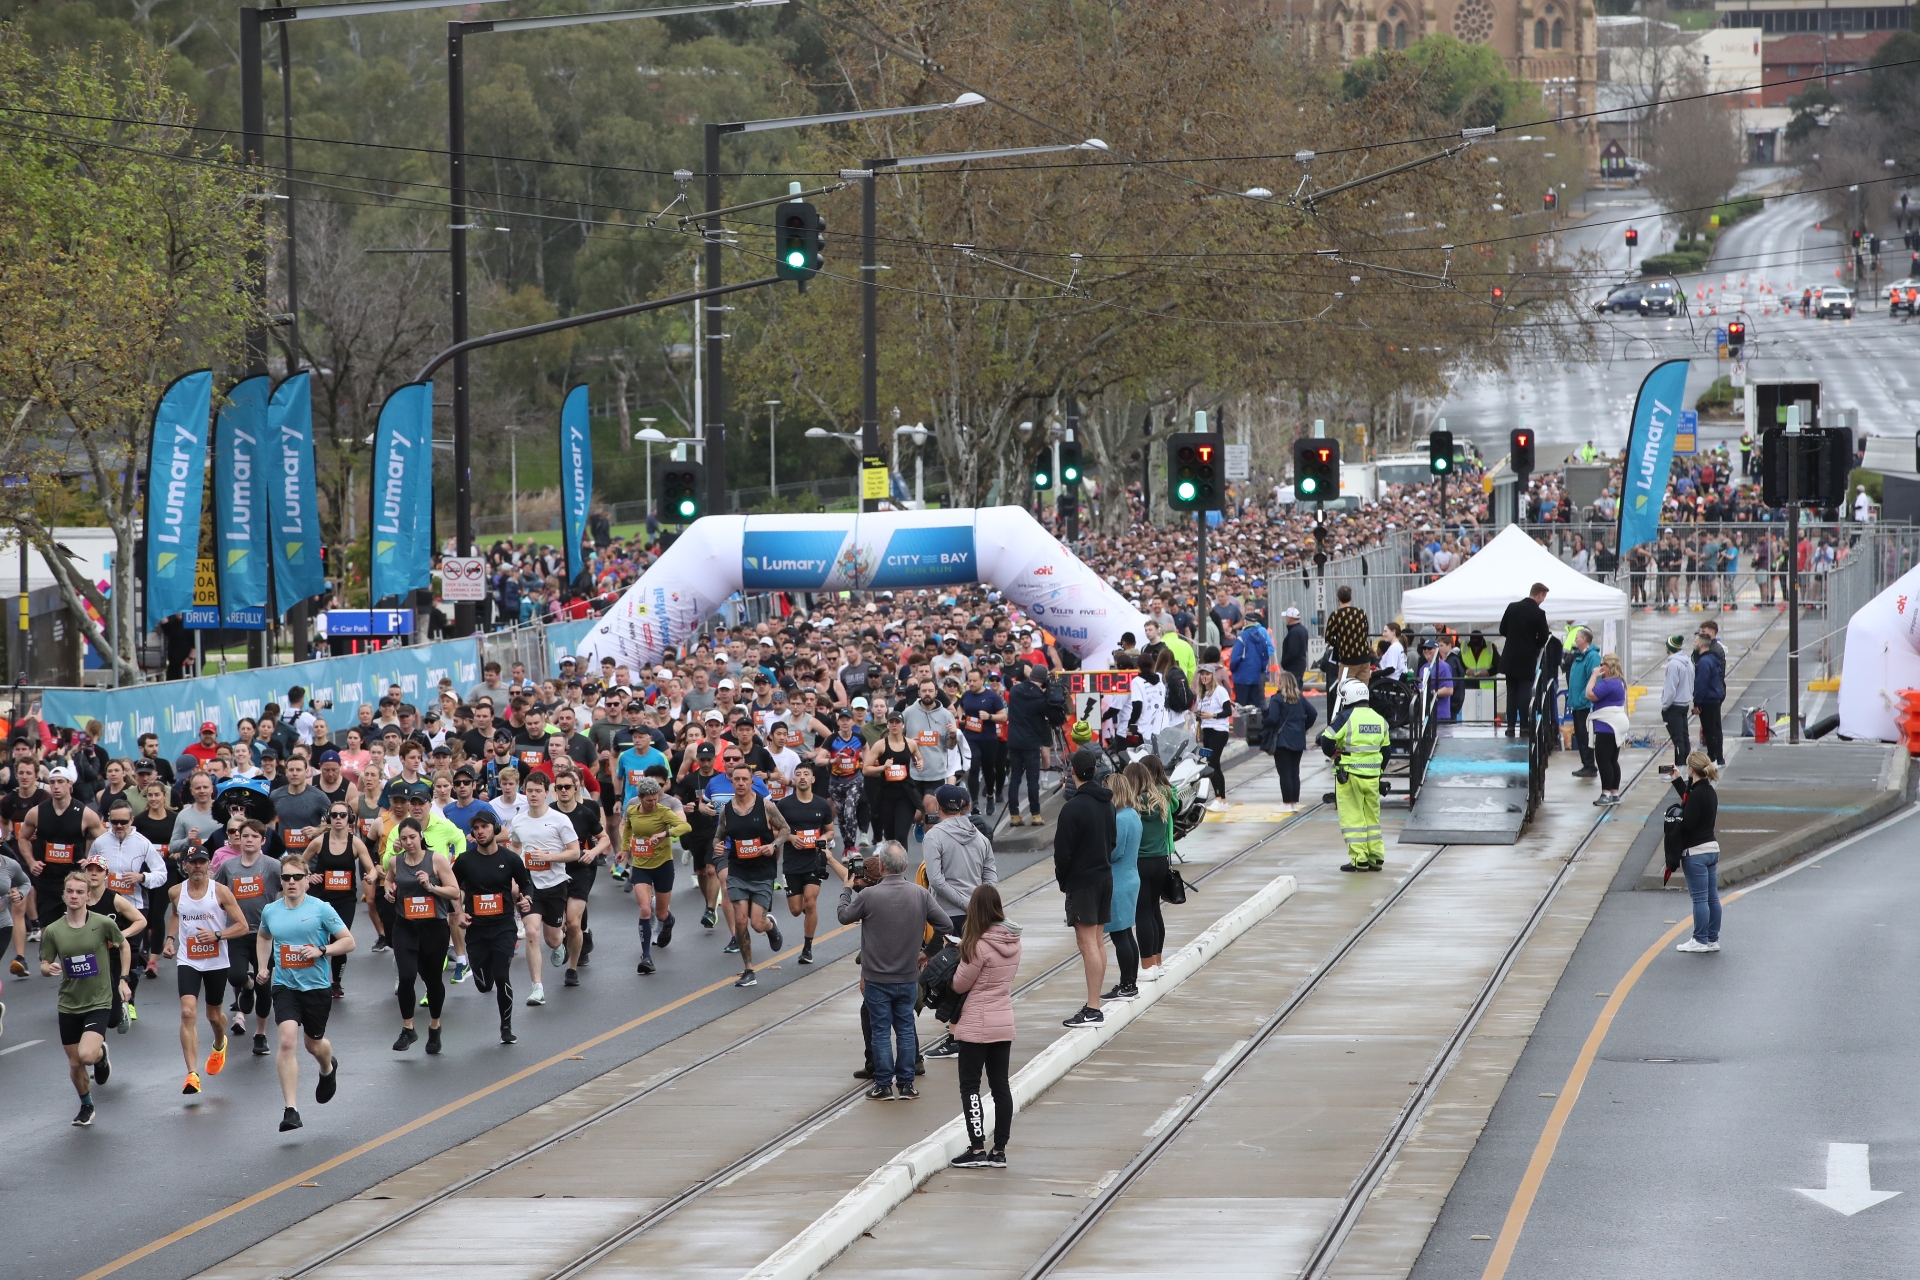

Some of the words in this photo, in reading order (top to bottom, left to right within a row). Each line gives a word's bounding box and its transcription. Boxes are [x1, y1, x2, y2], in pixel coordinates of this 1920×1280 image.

[1637, 399, 1672, 489] Lumary
[1200, 448, 1211, 461] T
[1319, 450, 1329, 461] T
[570, 426, 584, 516] Lumary
[158, 424, 197, 543] Lumary
[226, 428, 256, 540] Lumary
[282, 425, 303, 533] Lumary
[377, 430, 411, 534] Lumary
[763, 556, 826, 573] Lumary
[887, 555, 920, 566] CITY
[941, 553, 968, 563] BAY
[196, 577, 214, 587] OA
[186, 612, 215, 622] DRIVE
[218, 612, 262, 623] AREFULLY
[388, 613, 402, 632] P
[1060, 625, 1087, 638] Mail
[238, 884, 259, 893] 4205
[191, 944, 214, 952] 6605
[71, 963, 91, 972] 1513
[970, 1094, 982, 1137] adidas
